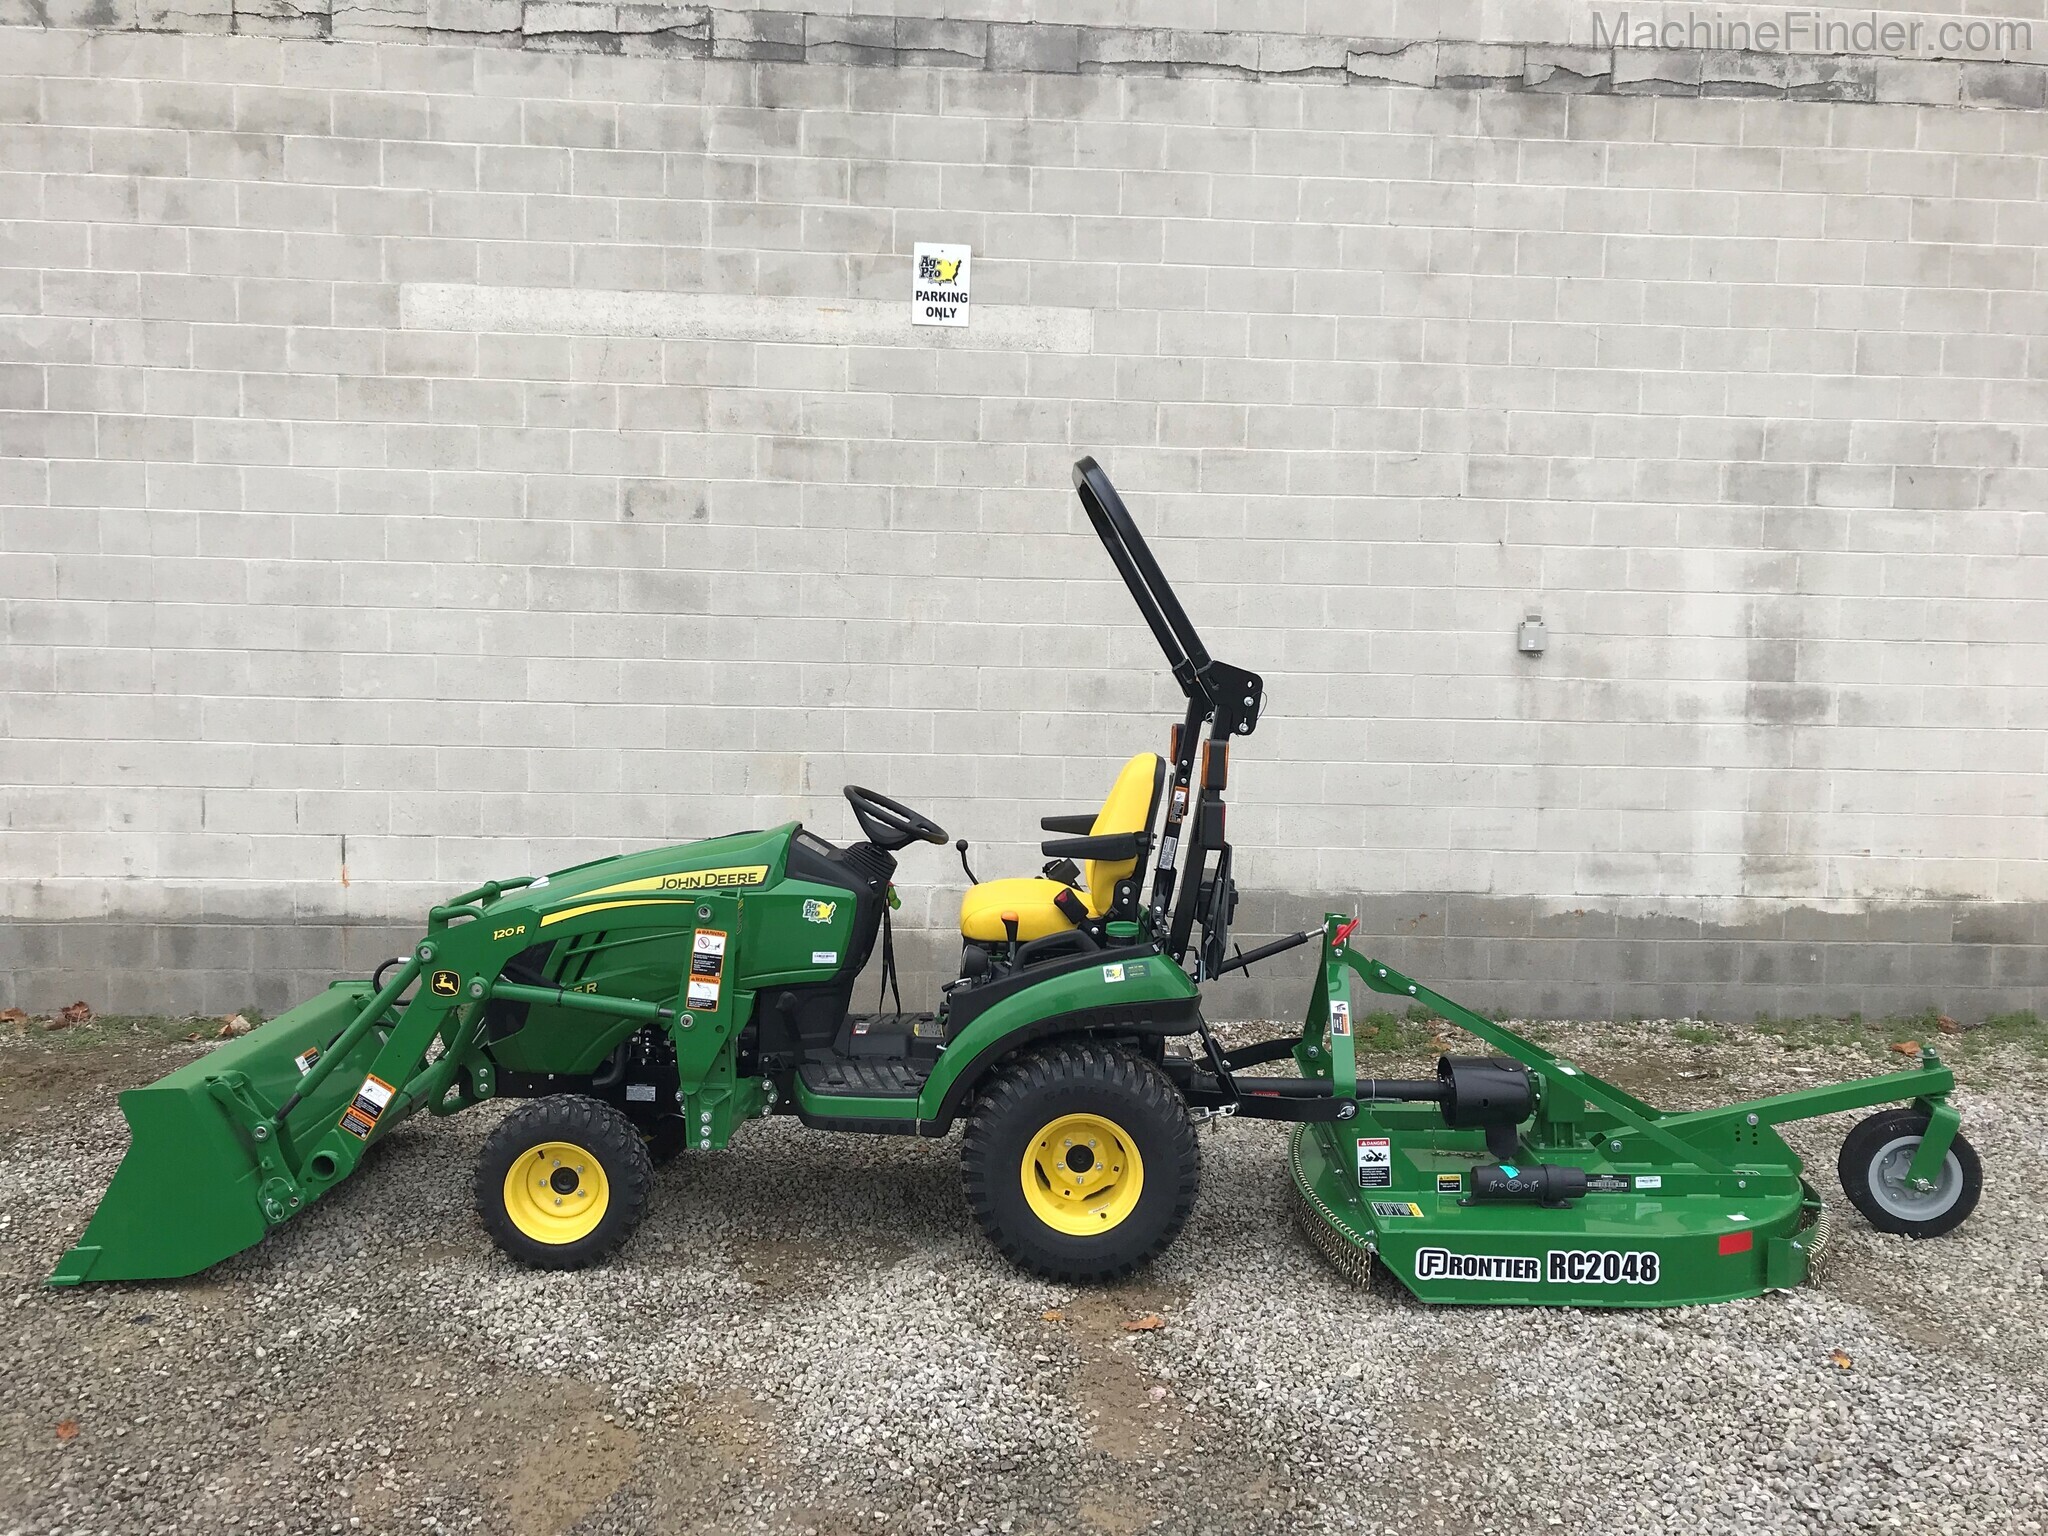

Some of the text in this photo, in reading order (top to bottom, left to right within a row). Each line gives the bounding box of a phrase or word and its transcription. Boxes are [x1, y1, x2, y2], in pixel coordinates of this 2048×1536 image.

[920, 267, 942, 279] Pro
[915, 290, 968, 303] PARKING
[926, 306, 957, 319] ONLY
[656, 872, 758, 890] JOHN DEERE
[804, 908, 821, 918] Pro
[493, 925, 526, 941] 120 R
[1418, 1249, 1658, 1282] FRONTIER RC2048
